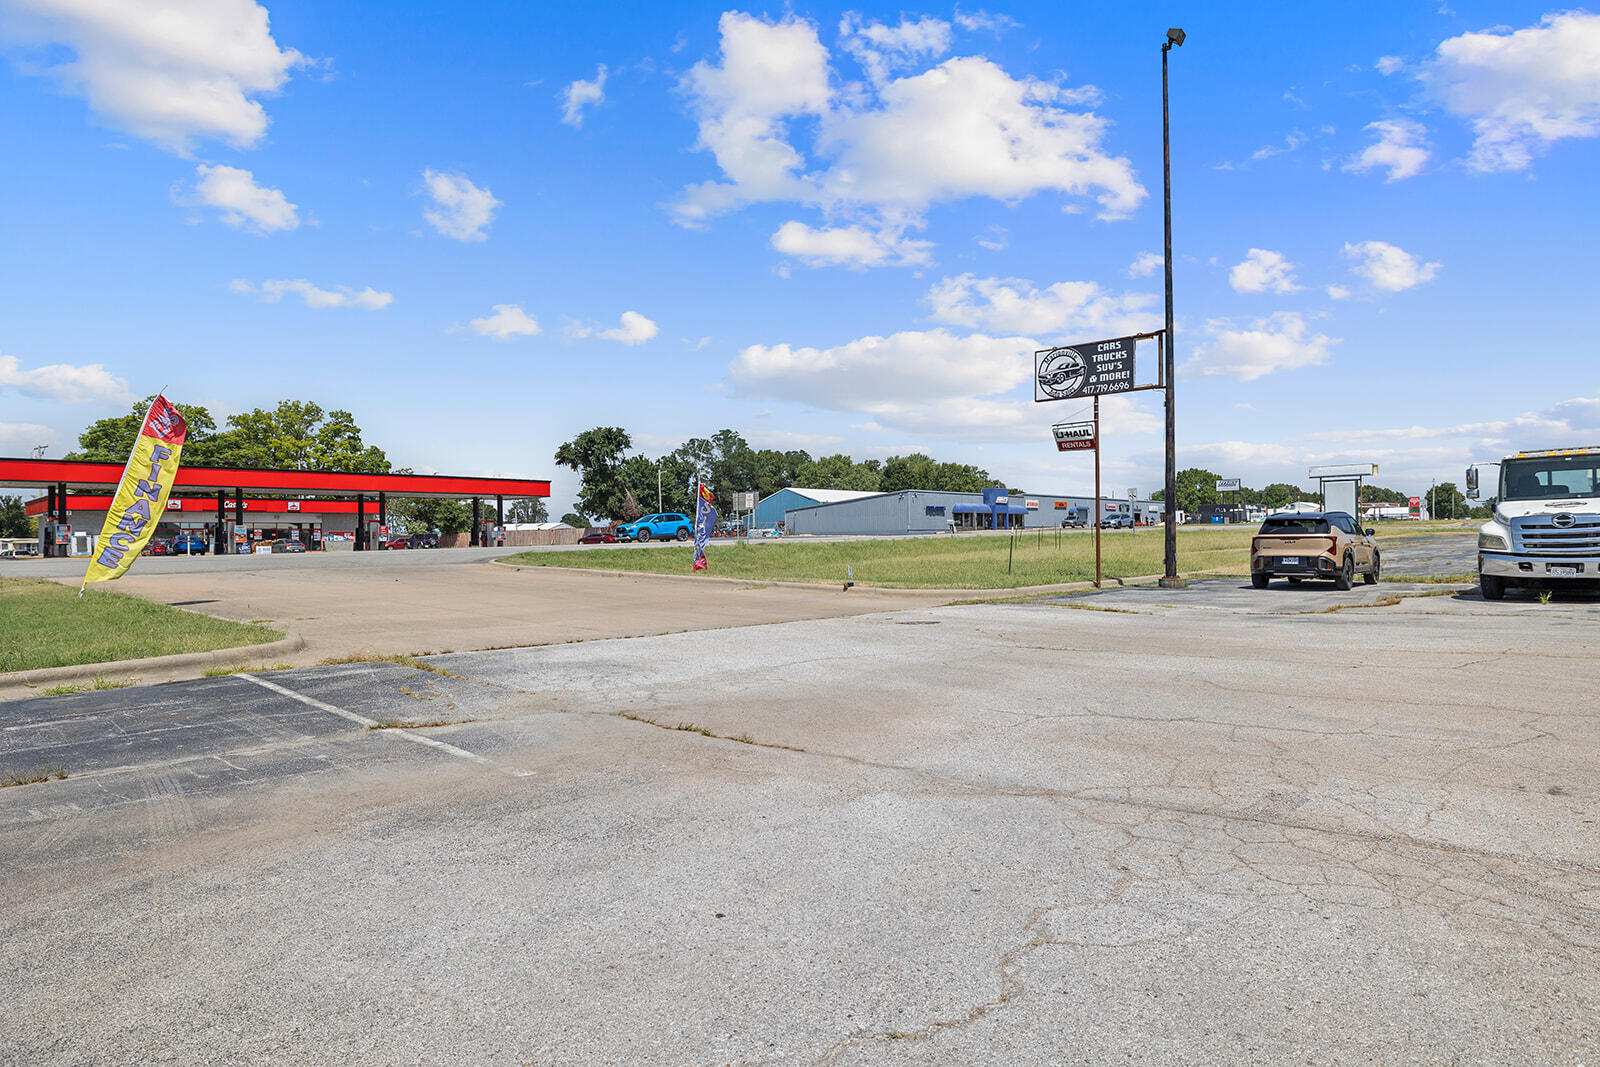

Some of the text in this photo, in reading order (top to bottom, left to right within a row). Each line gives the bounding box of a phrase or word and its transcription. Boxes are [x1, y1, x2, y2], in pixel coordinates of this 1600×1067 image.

[1097, 341, 1121, 352] CARS
[1092, 350, 1127, 363] TRUCKS
[1096, 361, 1123, 372] SUV'S
[1089, 370, 1130, 383] & MORE!
[1082, 381, 1130, 394] 417.719.6696
[149, 405, 180, 438] EAS
[1055, 429, 1092, 439] U-HAUL
[1061, 441, 1091, 449] RENTALS
[96, 444, 172, 569] FINANCE
[223, 500, 249, 509] Cas's
